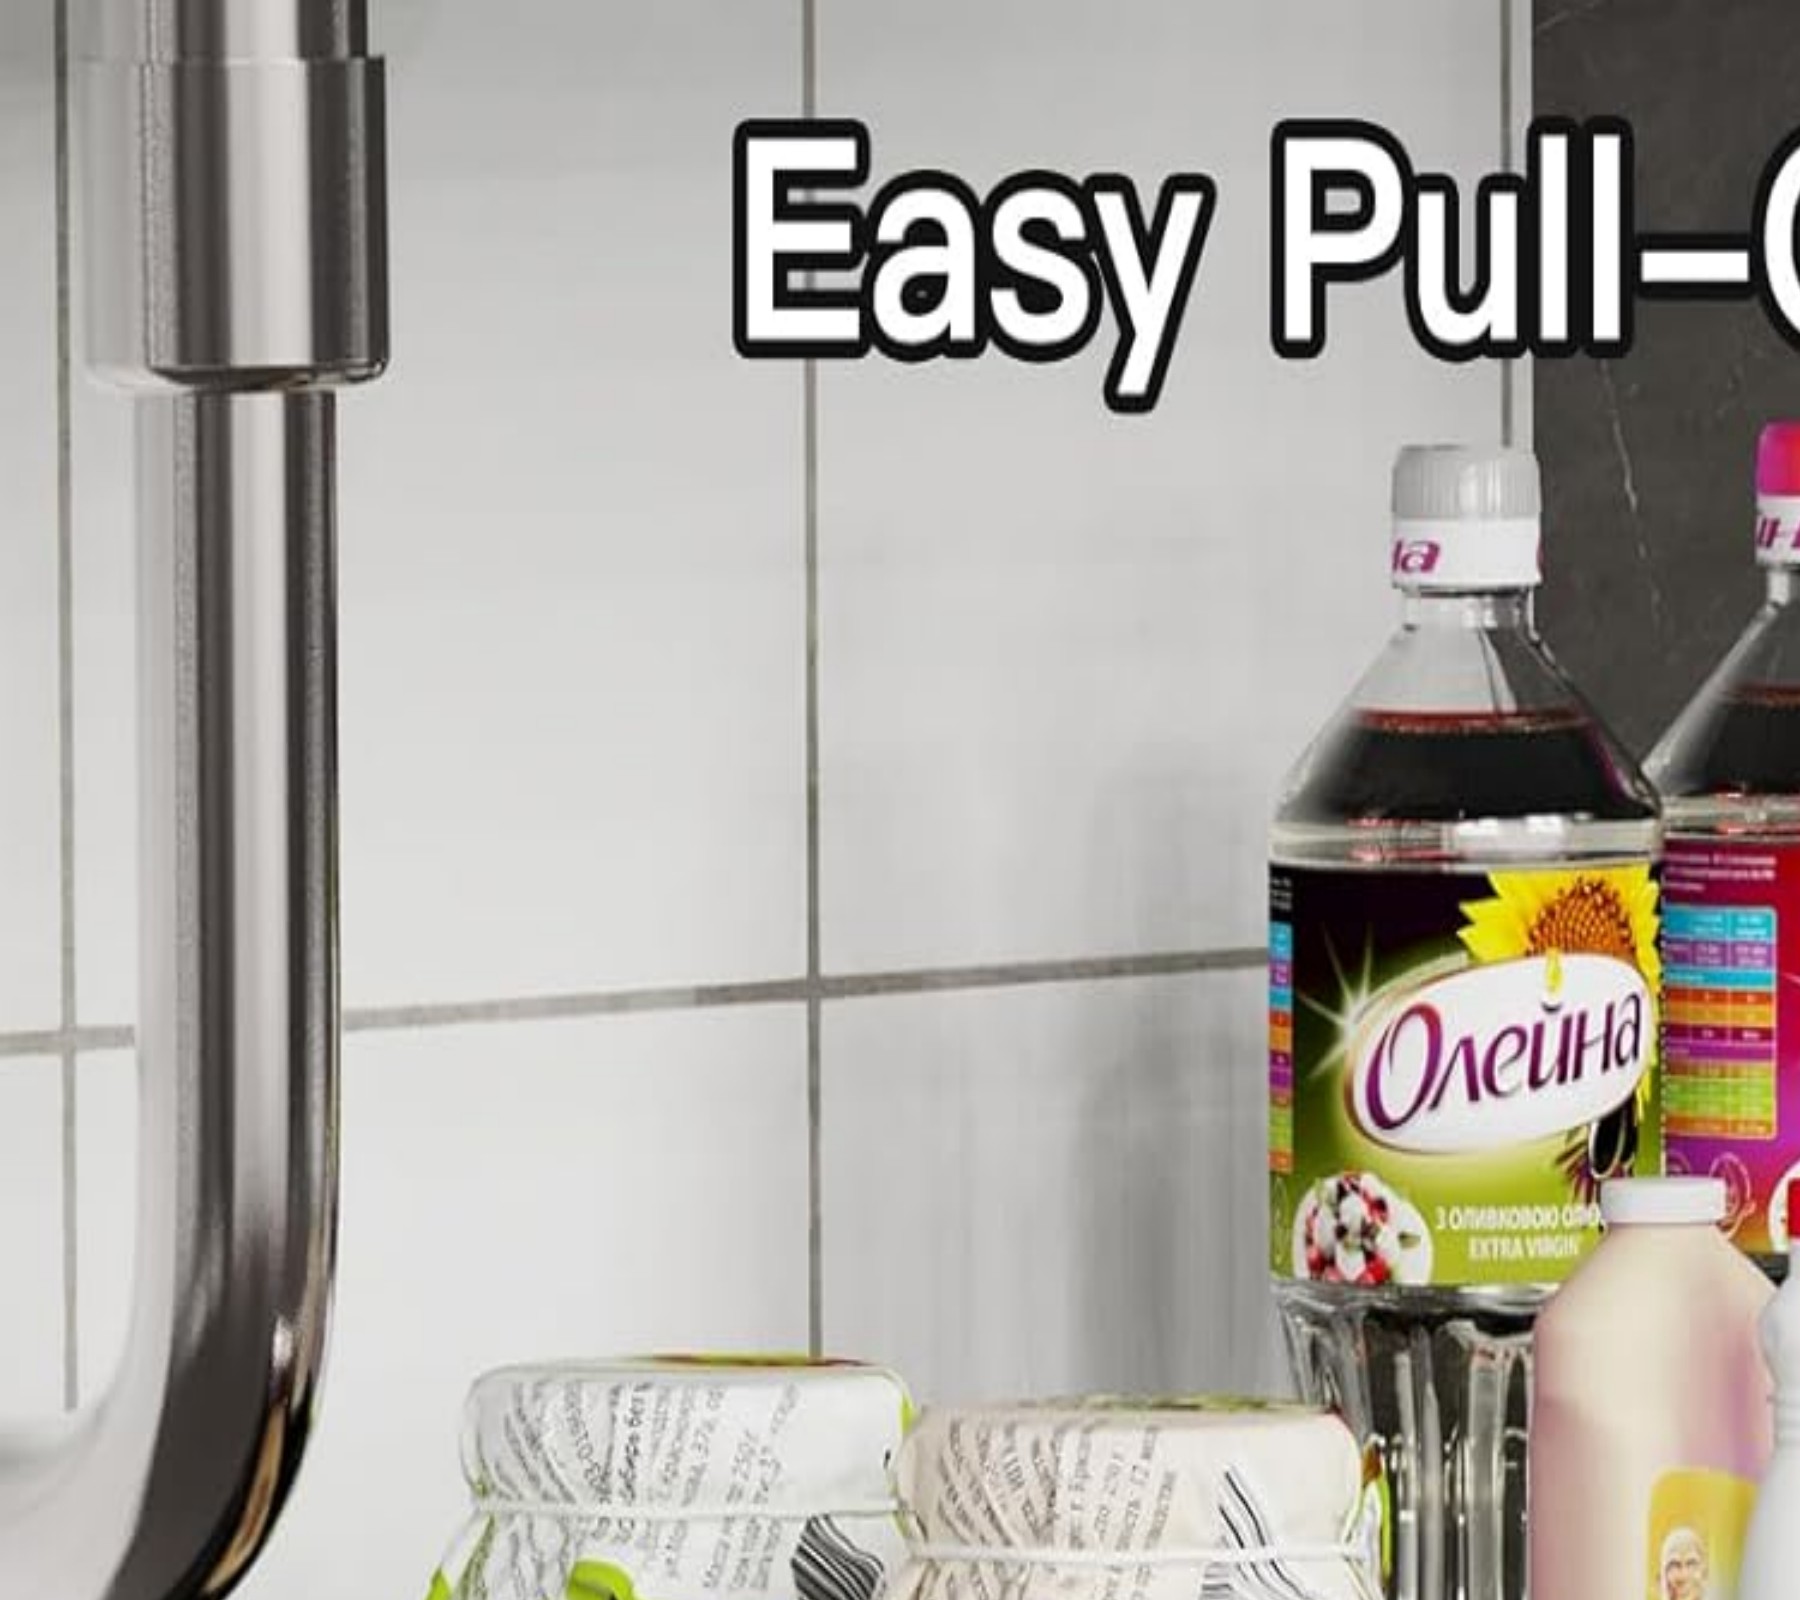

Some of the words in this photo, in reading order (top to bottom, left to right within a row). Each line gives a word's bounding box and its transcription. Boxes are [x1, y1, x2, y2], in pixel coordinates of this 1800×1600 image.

[1366, 992, 1642, 1130] Олейна
[1469, 1238, 1526, 1259] EXTRA
[1528, 1235, 1579, 1257] VIRGIN
